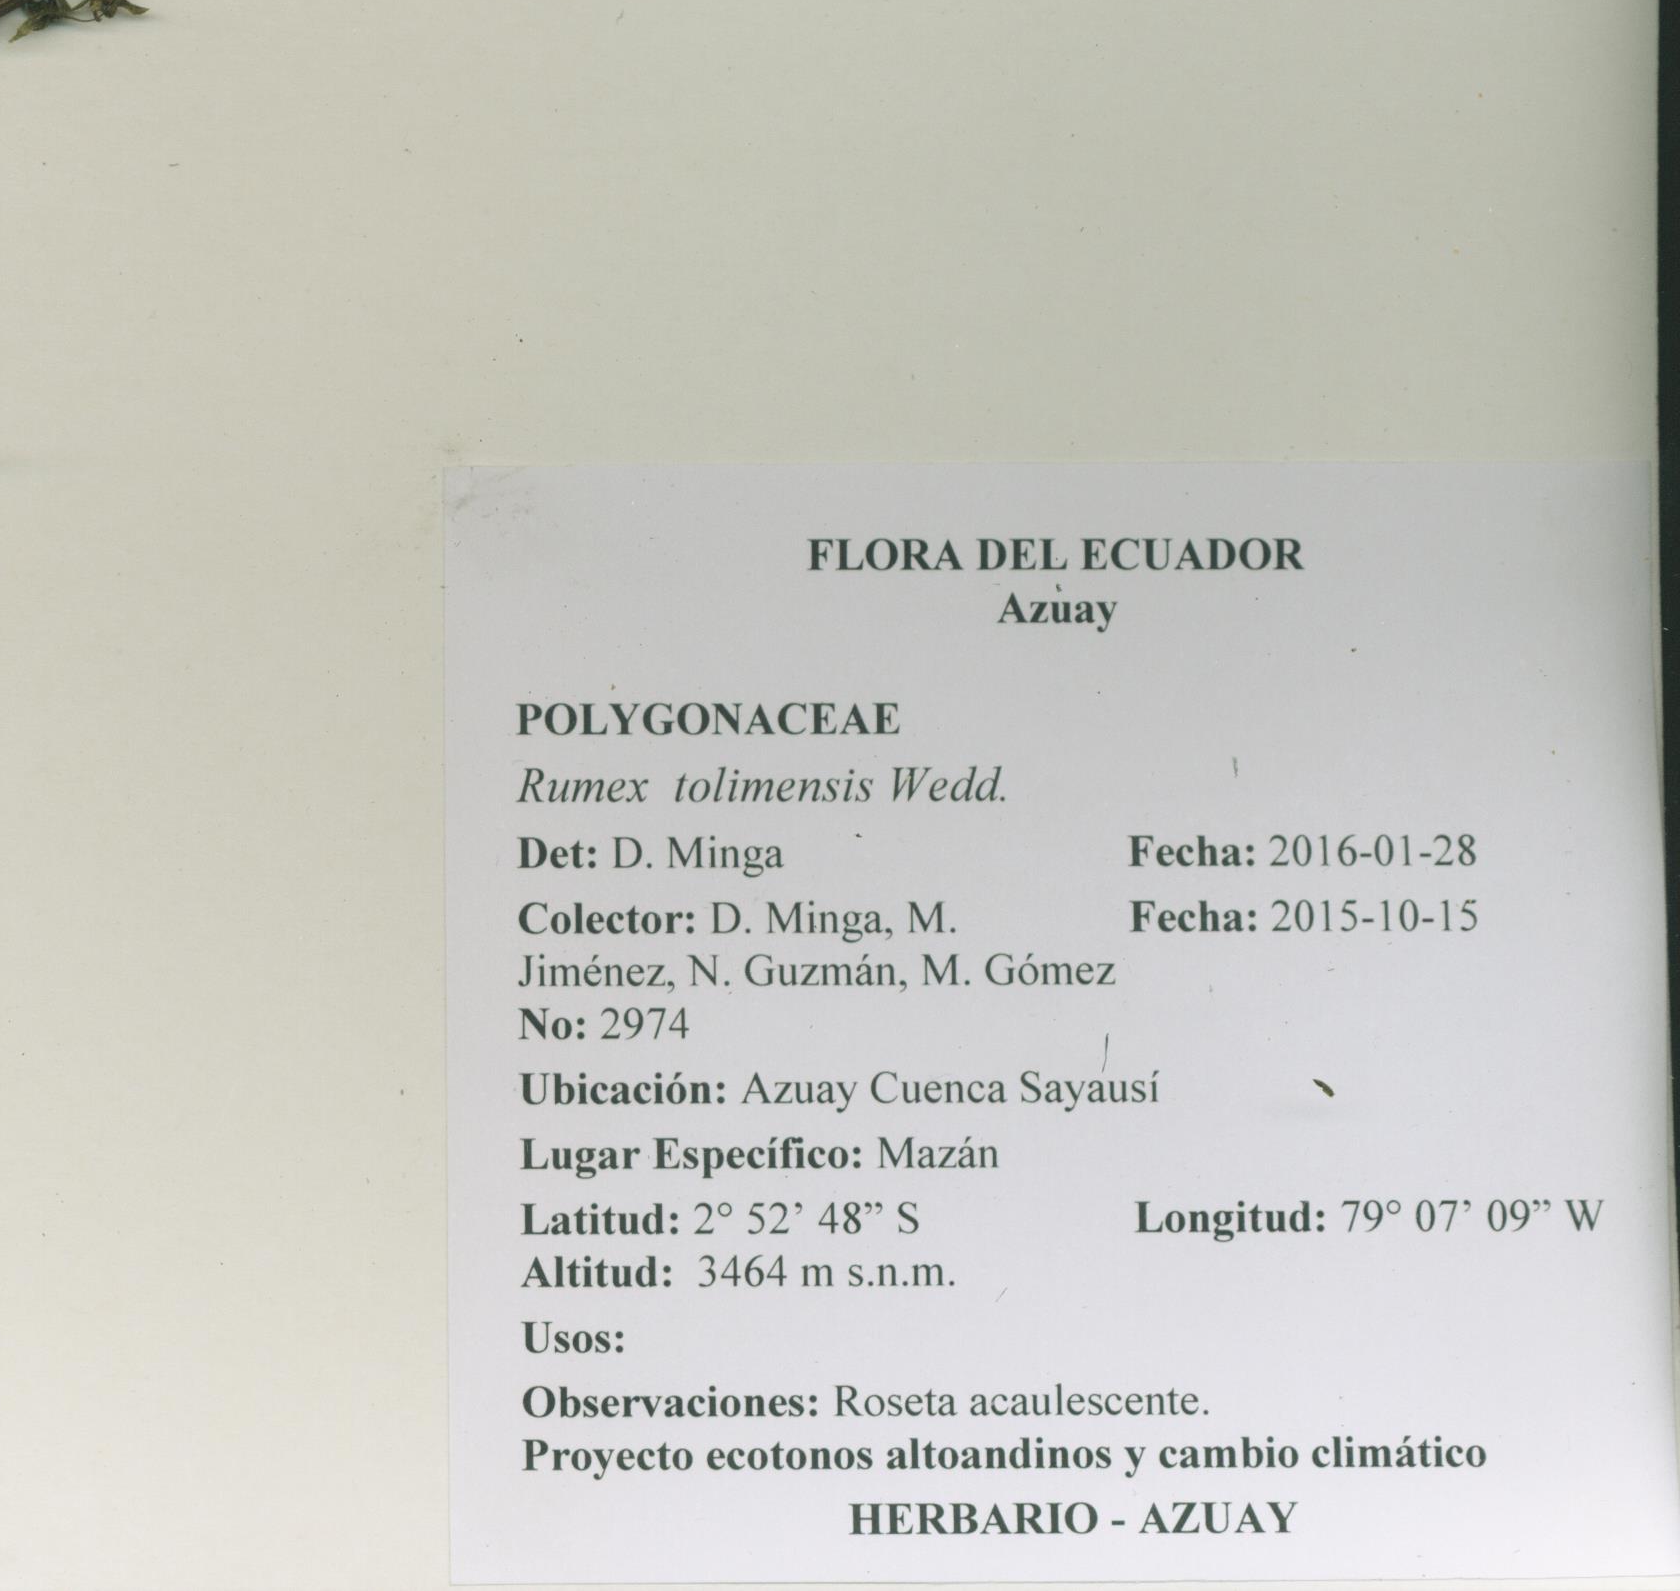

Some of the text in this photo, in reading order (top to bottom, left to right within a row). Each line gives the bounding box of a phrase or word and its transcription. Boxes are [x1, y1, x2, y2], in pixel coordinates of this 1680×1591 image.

[808, 537, 1305, 571] FLORA DEL ECUADOR
[997, 593, 1118, 634] Azuay
[516, 702, 900, 736] POLYGONACEAE
[516, 765, 1008, 803] Rumex tolimensis Wedd.
[517, 835, 785, 879] Det: D. Minga
[1128, 833, 1477, 868] Fecha: 2016-01-28
[518, 900, 956, 944] Colector: D. Minga, M.
[1129, 898, 1478, 933] Fecha: 2015-10-15
[517, 952, 1116, 993] Jiménez, N. Guzmán, M. Gómez
[518, 1006, 690, 1041] No: 2974
[519, 1070, 1160, 1114] Ubicación: Azuay Cuenca Sayausí
[519, 1135, 999, 1180] Lugar Específico: Mazán
[520, 1202, 679, 1236] Latitud:
[897, 1201, 920, 1235] S
[1134, 1200, 1325, 1243] Longitud:
[1564, 1199, 1604, 1232] W
[520, 1254, 955, 1289] Altitud: 3464 m s.n.m.
[520, 1321, 624, 1354] Usos:
[522, 1382, 1209, 1419] Observaciones: Roseta acaulescente.
[521, 1435, 1487, 1481] Proyecto ecotonos altoandinos y cambio climático
[848, 1501, 1099, 1536] HERBARIO
[1138, 1501, 1298, 1534] AZUAY
